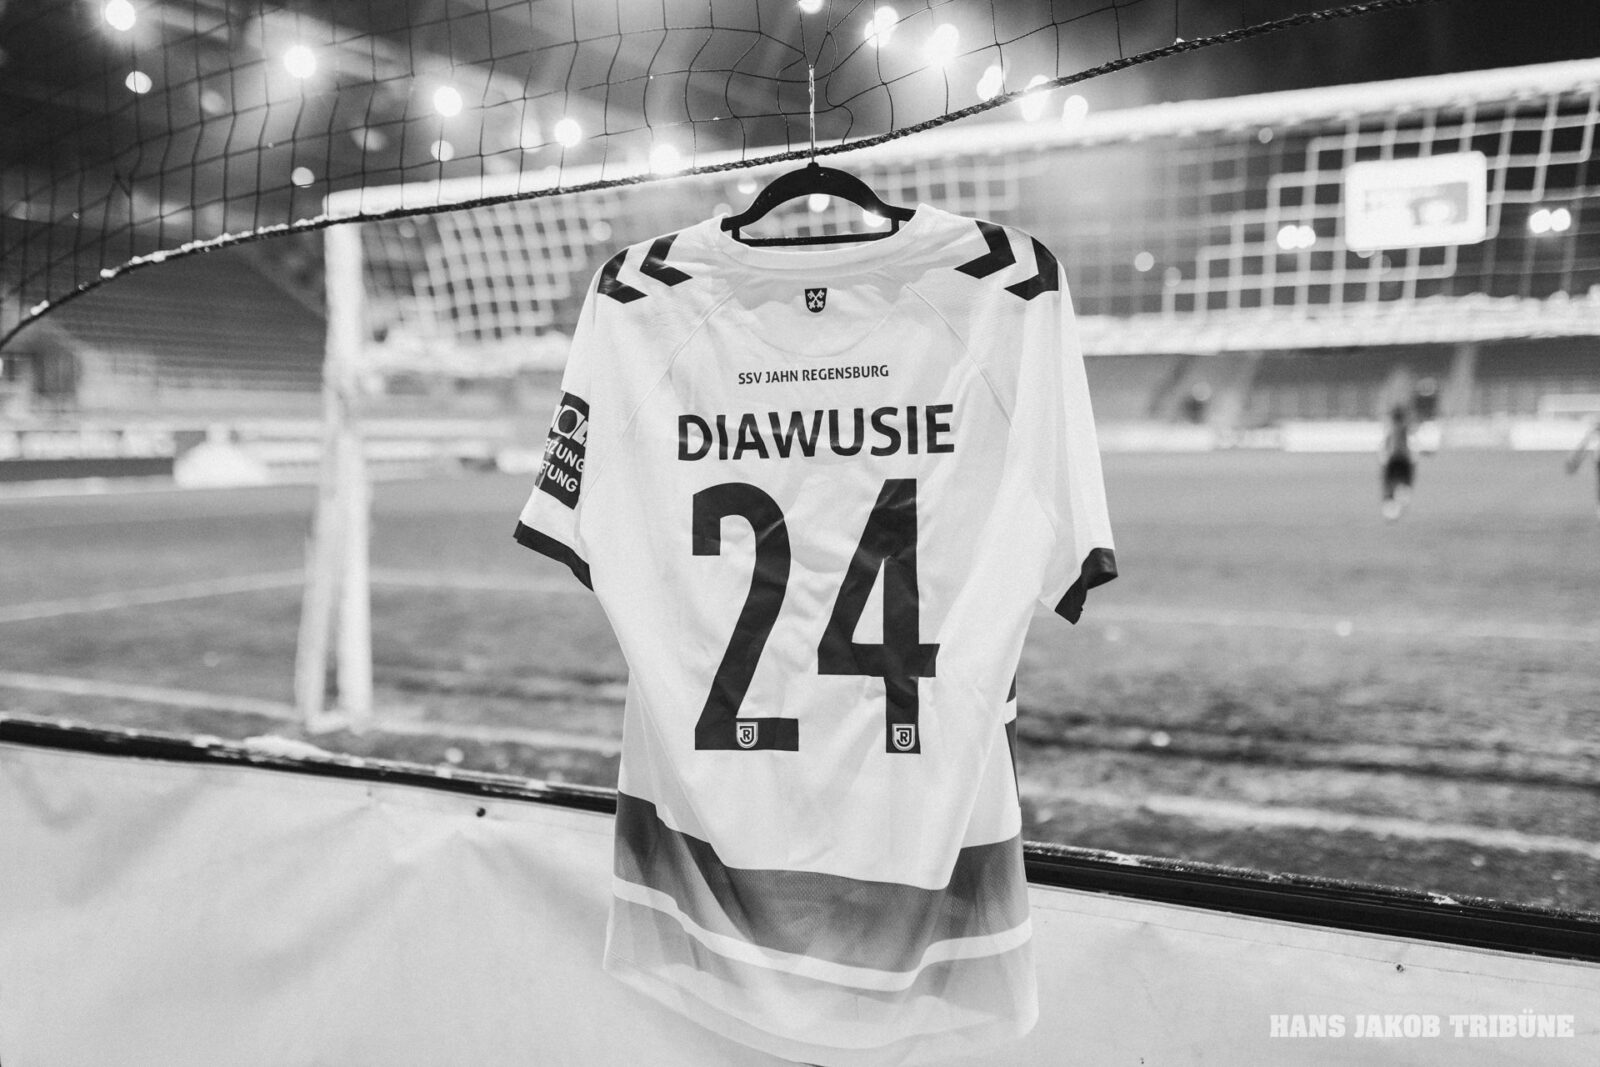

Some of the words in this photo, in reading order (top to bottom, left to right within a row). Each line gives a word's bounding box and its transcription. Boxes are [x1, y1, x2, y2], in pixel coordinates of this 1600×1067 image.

[739, 372, 762, 384] SSV
[766, 370, 798, 383] JAHN
[803, 365, 888, 381] REGENSBURG
[679, 404, 954, 461] DIAWUSIE
[693, 479, 940, 754] 24
